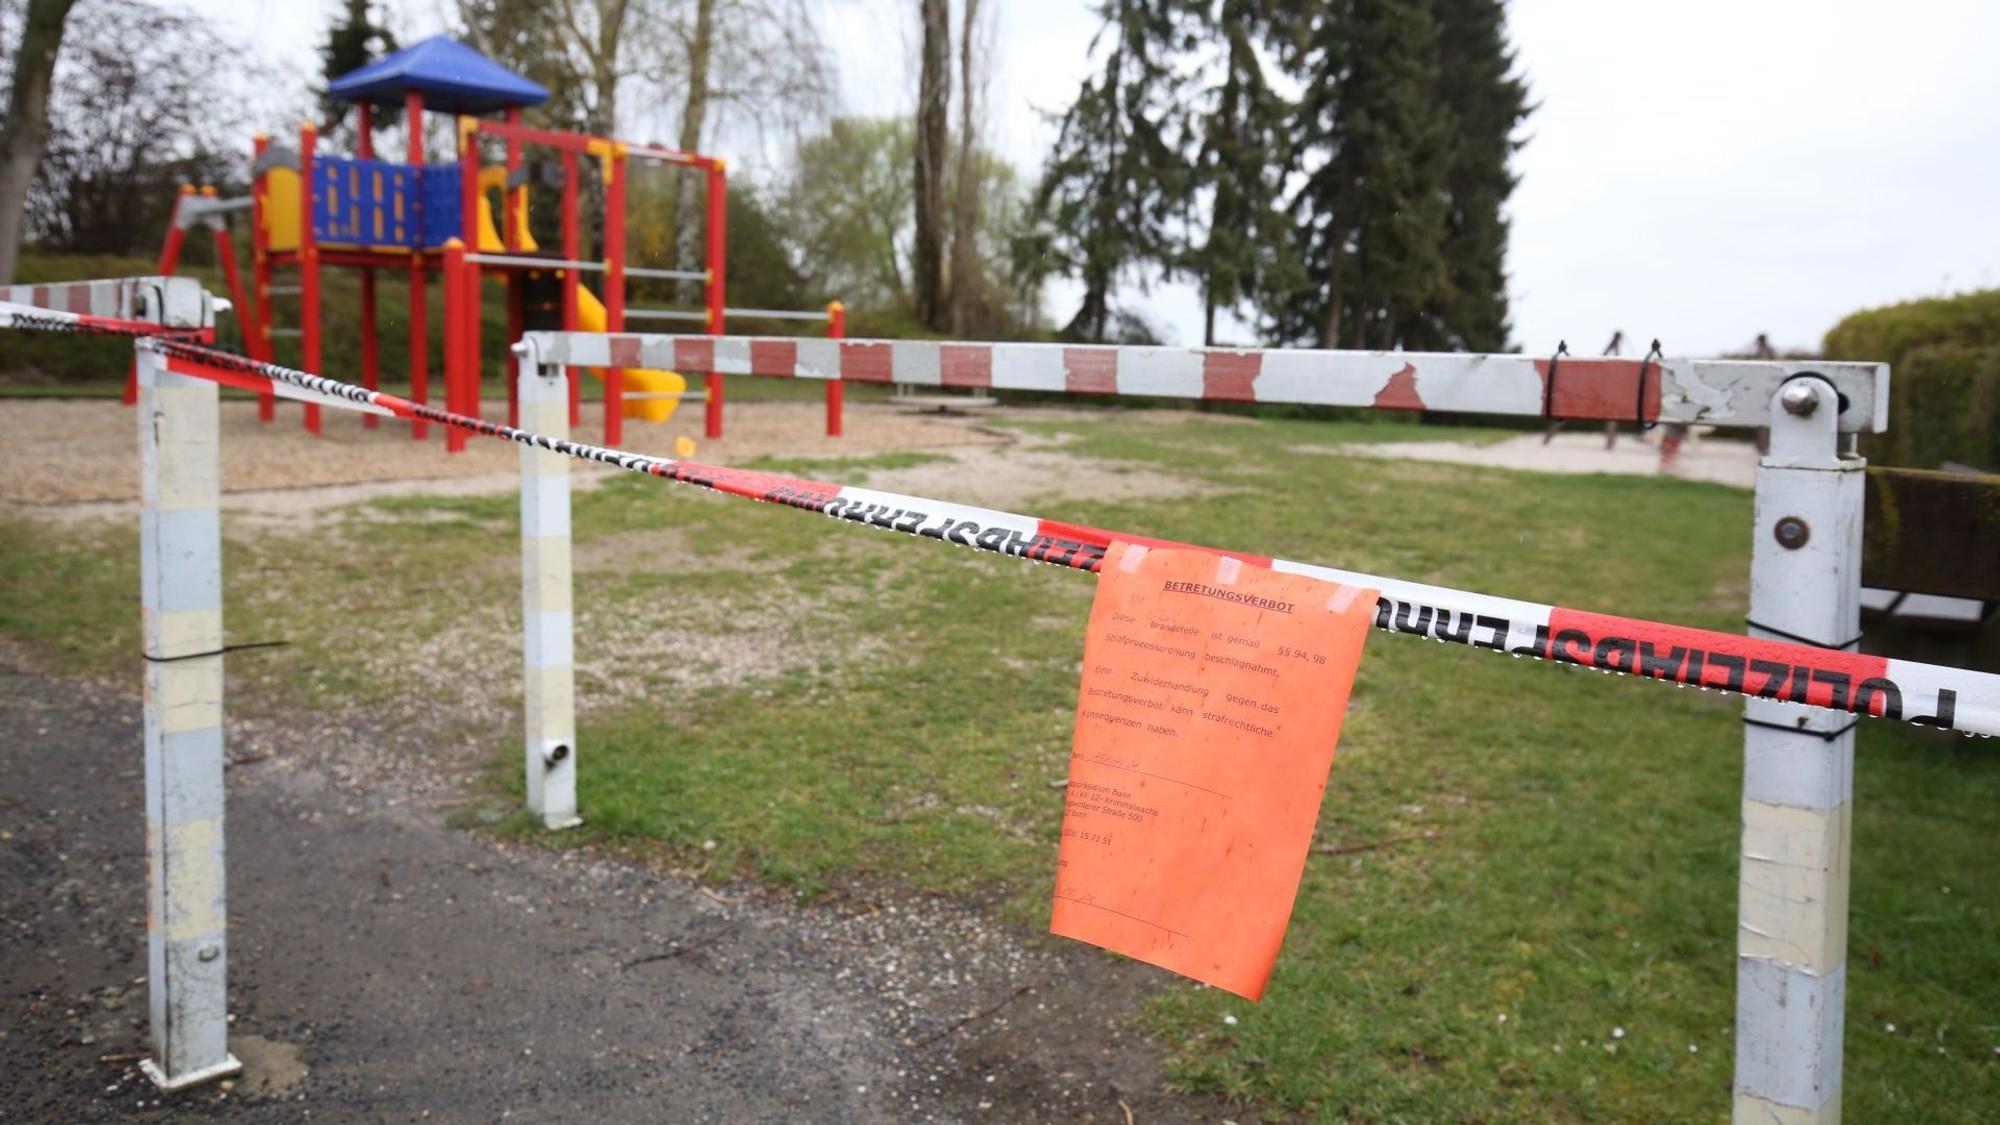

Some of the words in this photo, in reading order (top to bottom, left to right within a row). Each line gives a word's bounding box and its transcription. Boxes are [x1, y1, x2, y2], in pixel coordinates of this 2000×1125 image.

[1164, 580, 1296, 612] BETRETUNGSVERBOT
[1105, 632, 1197, 660] Strafprozessordnung
[1111, 611, 1136, 624] Diese
[1150, 620, 1200, 637] Brandstelle
[1211, 630, 1224, 641] ist
[1312, 653, 1327, 665] 98
[1087, 687, 1164, 711] Betretungsverbot
[1170, 704, 1194, 716] kann
[1202, 711, 1274, 738] strafrechtliche
[1130, 671, 1210, 697] Zuwiderhandlung
[1226, 692, 1257, 709] gegen
[1261, 702, 1280, 714] das
